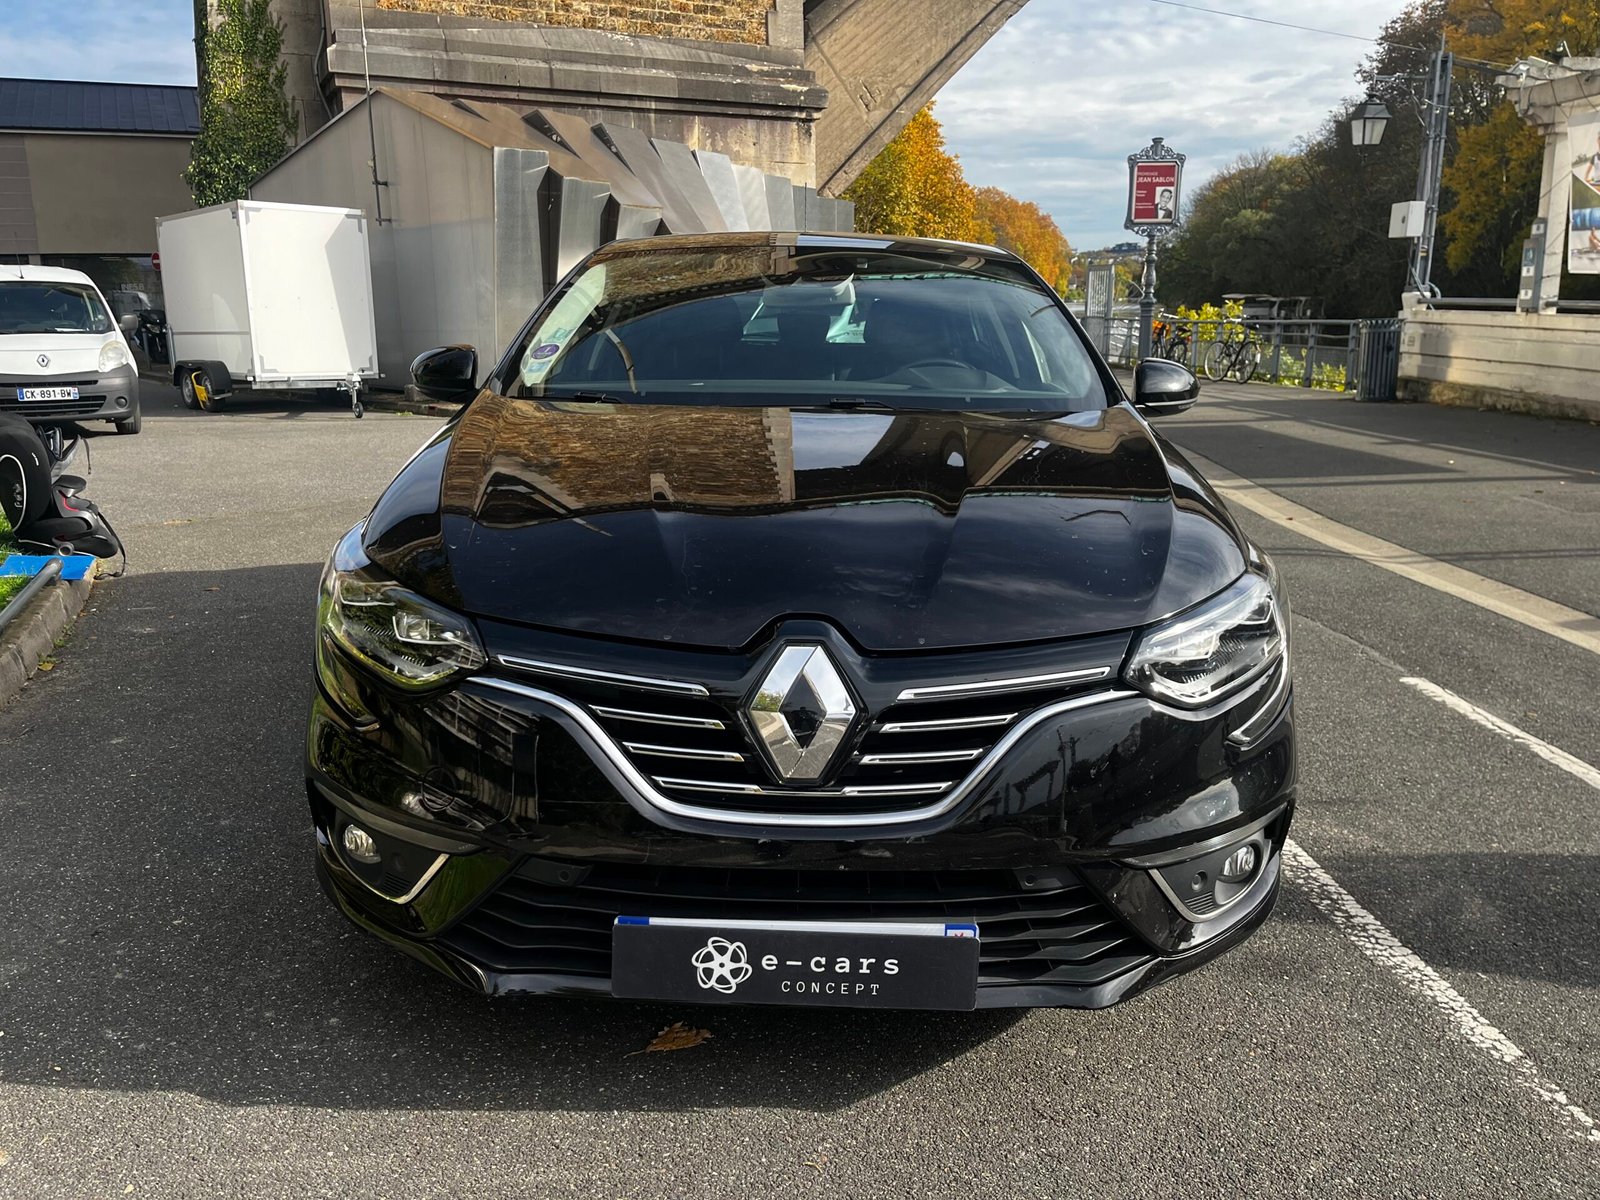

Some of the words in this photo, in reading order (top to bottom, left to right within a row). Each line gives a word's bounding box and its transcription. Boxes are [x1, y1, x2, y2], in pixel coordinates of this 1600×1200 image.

[24, 388, 72, 399] CK-891-BW
[761, 953, 901, 976] e-cars
[781, 980, 881, 996] CONCEPT
